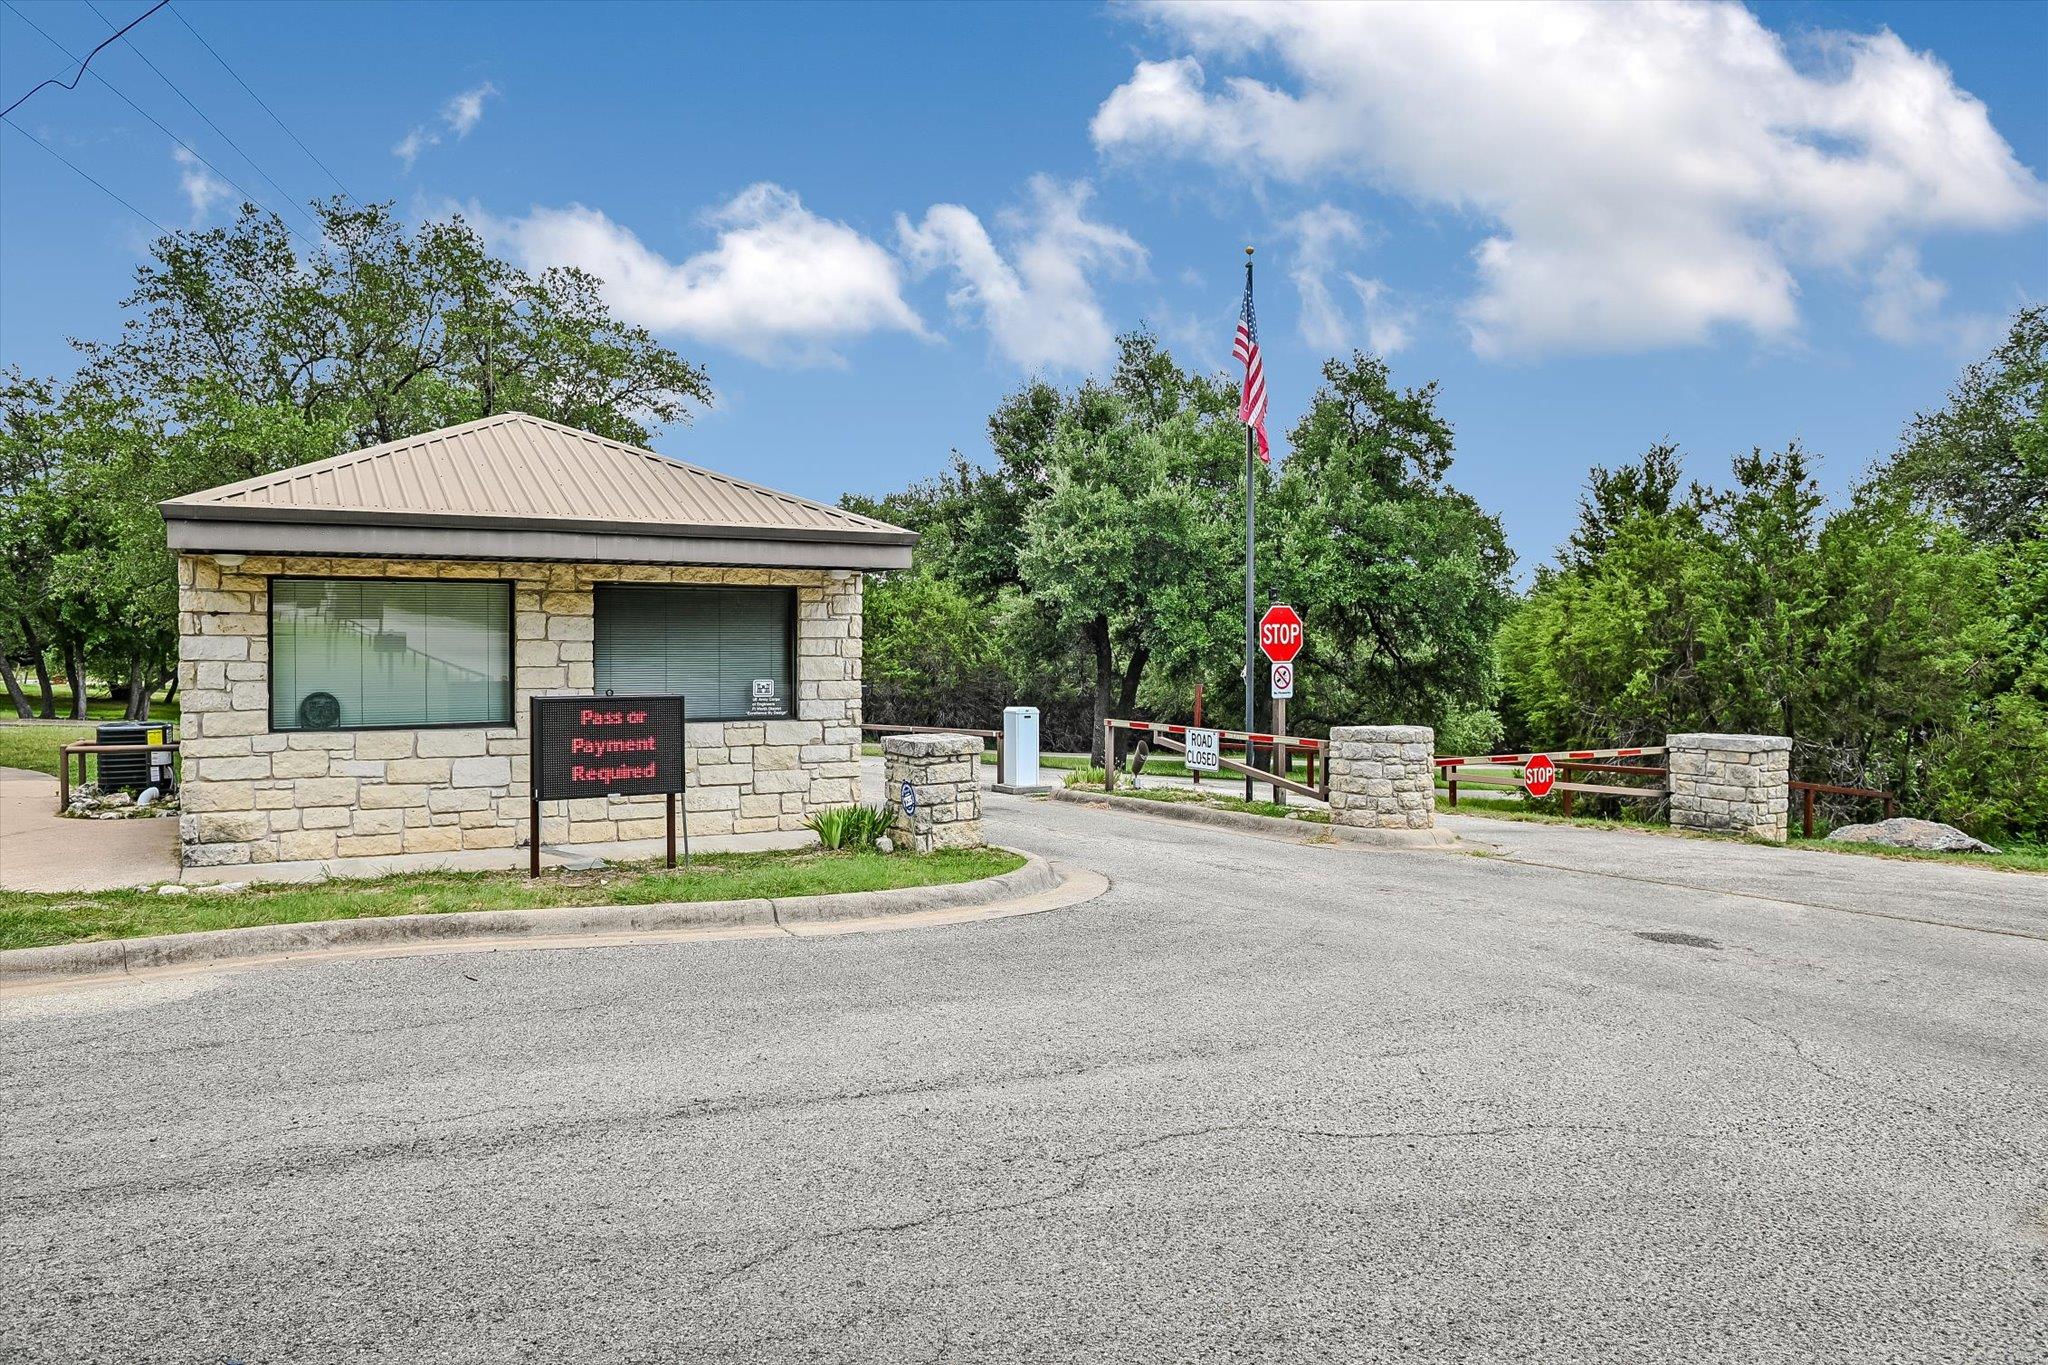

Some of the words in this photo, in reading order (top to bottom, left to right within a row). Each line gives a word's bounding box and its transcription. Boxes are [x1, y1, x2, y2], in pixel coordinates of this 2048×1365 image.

[1263, 623, 1300, 645] STOP
[580, 709, 623, 725] Pass
[626, 710, 648, 724] or
[571, 735, 657, 757] Payment
[1191, 732, 1213, 748] ROAD
[1186, 749, 1217, 767] CLOSED
[571, 761, 657, 784] Required
[1526, 766, 1553, 784] STOP
